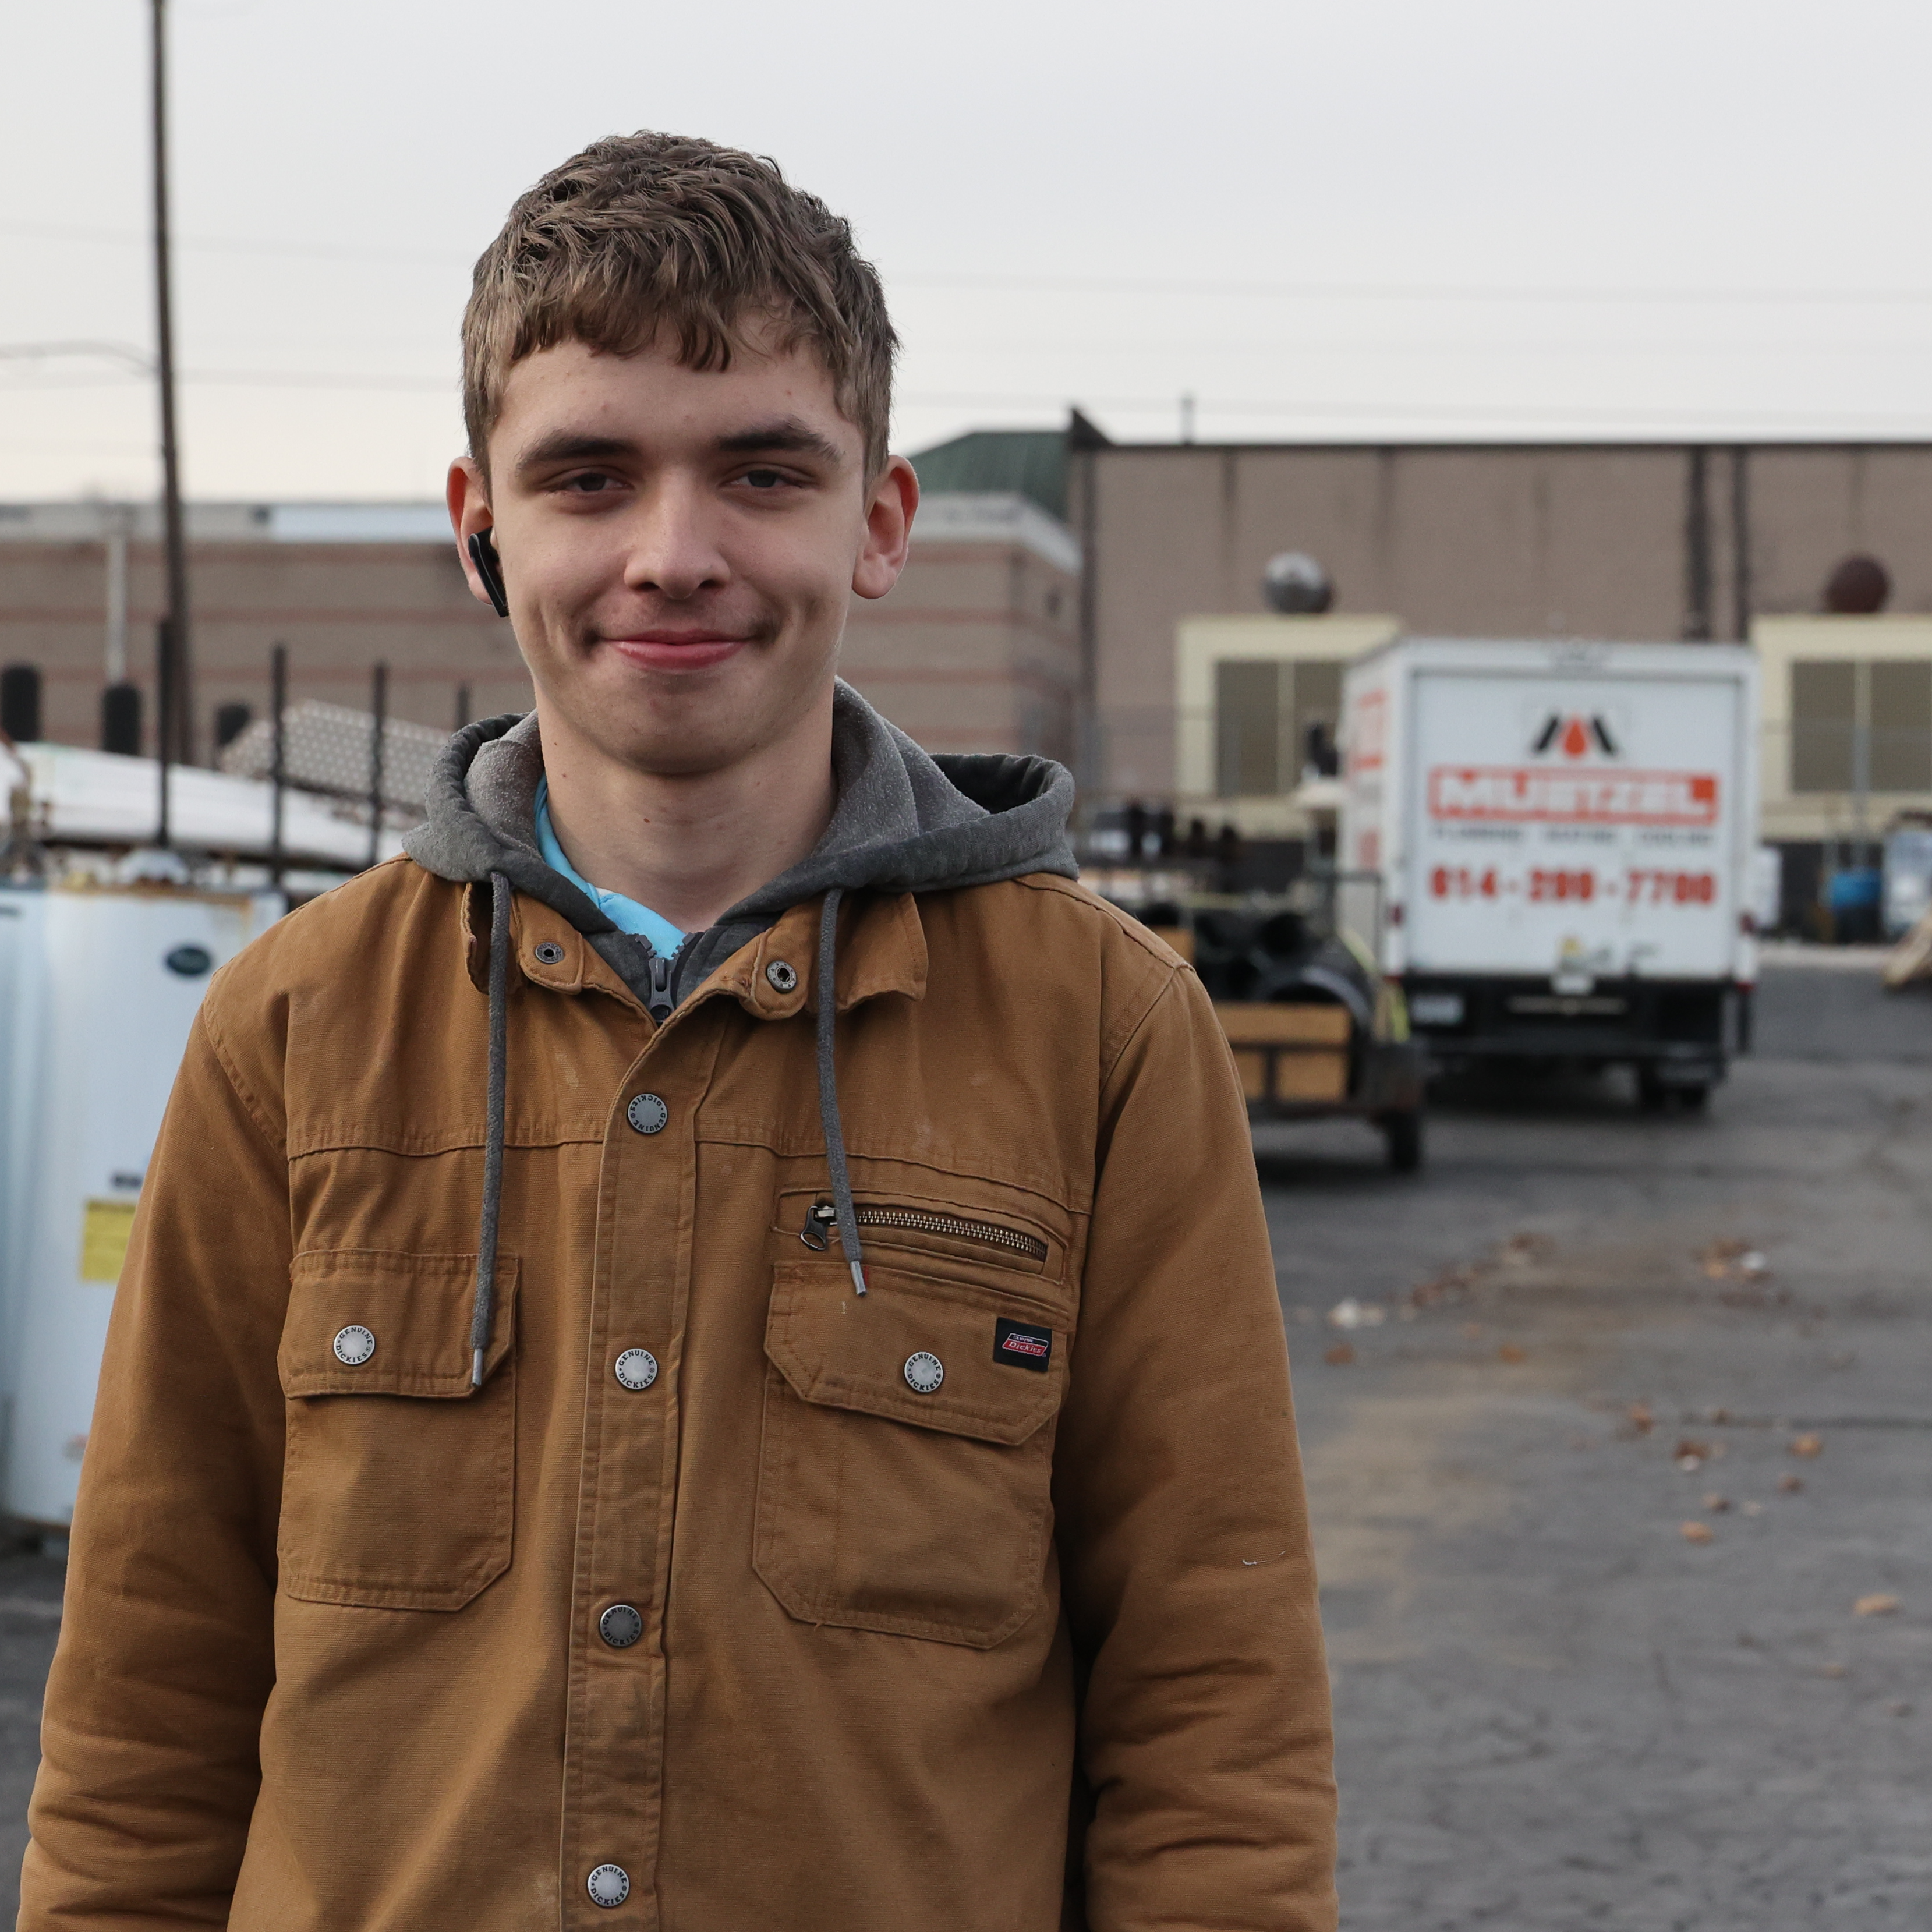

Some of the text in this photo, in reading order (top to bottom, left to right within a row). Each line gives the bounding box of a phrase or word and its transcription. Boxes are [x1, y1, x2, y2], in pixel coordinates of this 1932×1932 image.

[629, 1095, 666, 1132] GENUINE DICKIES
[336, 1326, 373, 1363] GENUINE DICKIES
[1008, 1341, 1042, 1354] Dickies
[618, 1350, 654, 1388] GENUINE DICKIES
[908, 1353, 942, 1391] GENUINE DICKIES
[602, 1607, 639, 1645] GENUINE DICKIES
[590, 1866, 628, 1905] GENUINE DICKIES
